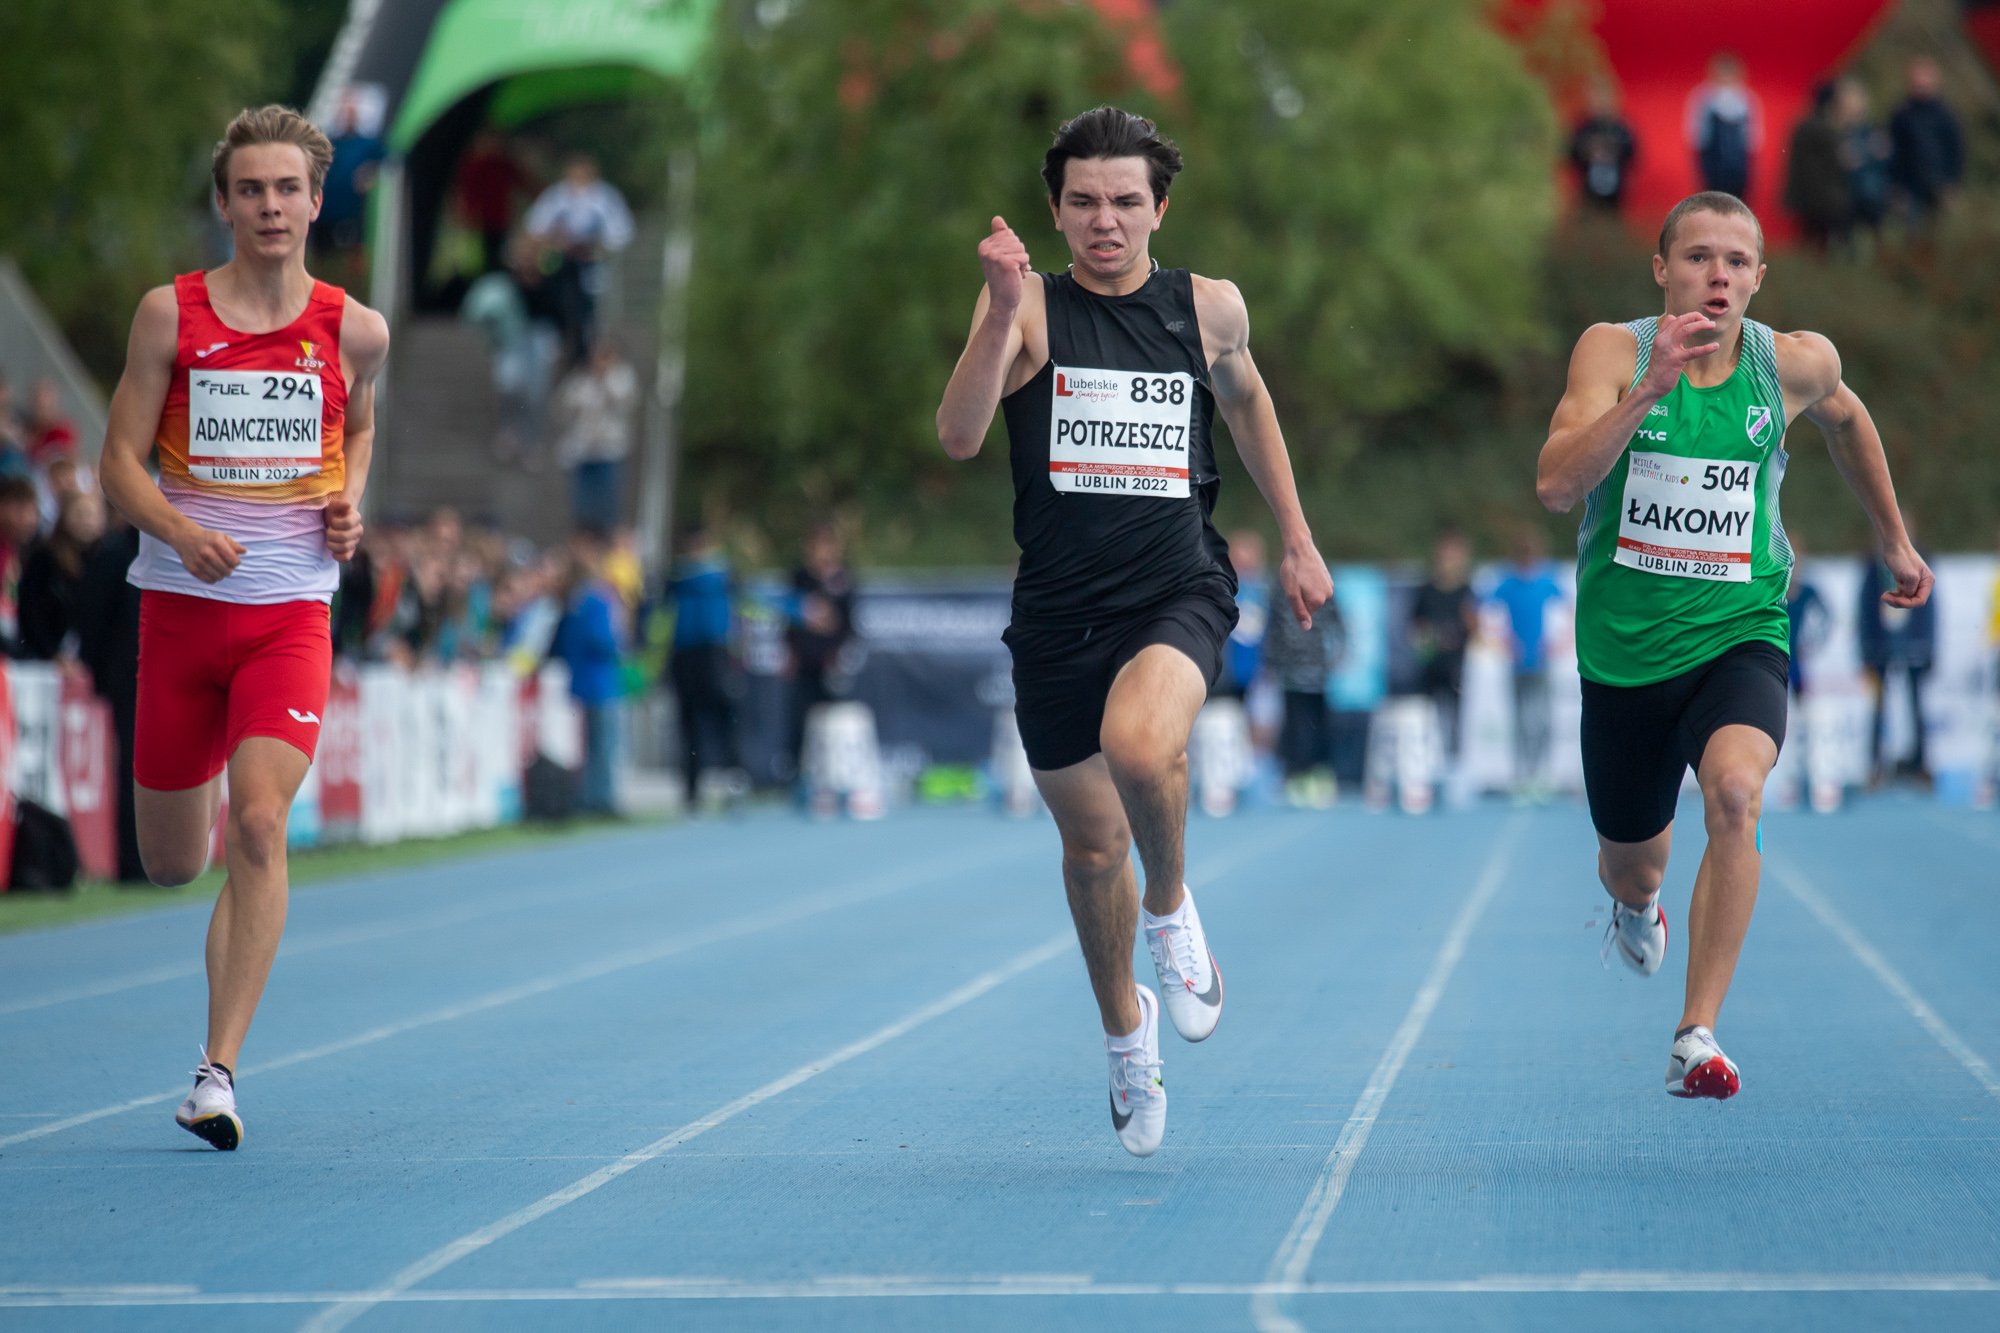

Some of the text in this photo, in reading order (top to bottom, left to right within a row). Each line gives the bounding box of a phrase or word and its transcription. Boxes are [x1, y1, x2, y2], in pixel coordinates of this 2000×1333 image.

[209, 384, 250, 395] FUEL
[262, 376, 315, 400] 294
[1070, 378, 1118, 391] lubelskie
[1130, 377, 1185, 405] 838
[195, 418, 317, 442] ADAMCZEWSKI
[1057, 419, 1185, 452] POTRZESZCZ
[1637, 429, 1667, 441] TLC
[212, 468, 299, 480] LUBLIN 2022
[1075, 475, 1168, 491] LUBLIN 2022
[1632, 467, 1679, 484] HEALTHIER KIDS
[1702, 465, 1750, 491] 504
[1628, 498, 1750, 536] ŁAKOMY
[1638, 555, 1729, 576] LUBLIN 2022
